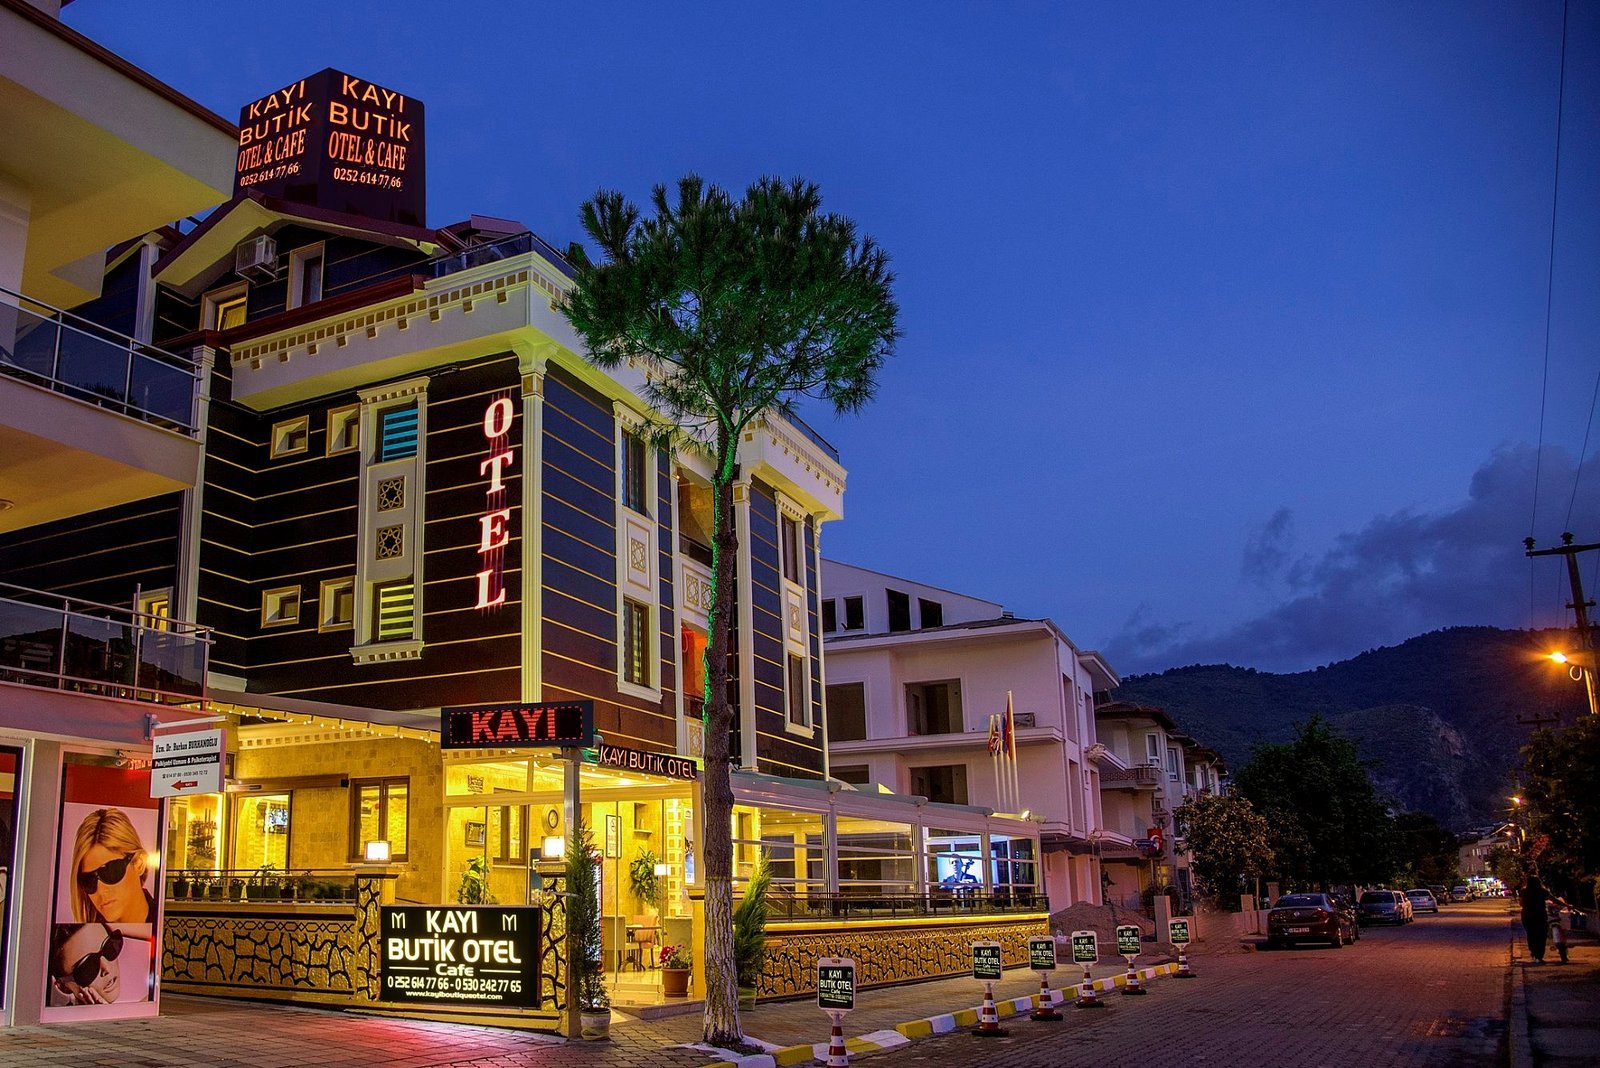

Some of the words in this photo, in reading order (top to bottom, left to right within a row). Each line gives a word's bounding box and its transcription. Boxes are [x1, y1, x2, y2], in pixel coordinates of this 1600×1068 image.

[249, 80, 306, 120] KAYI
[342, 75, 404, 113] KAYI
[240, 102, 312, 146] BUTİK
[329, 101, 412, 142] BUTİK
[238, 144, 262, 172] OTEL
[264, 140, 272, 164] &
[274, 128, 306, 162] CAFE
[328, 130, 363, 163] OTEL
[364, 138, 375, 166] &
[378, 141, 406, 171] CAFE
[240, 172, 258, 186] 0252
[260, 168, 274, 182] 614
[276, 165, 286, 178] 77
[287, 162, 299, 174] 66
[334, 168, 358, 182] 0252
[360, 172, 378, 184] 614
[379, 174, 390, 186] 77
[390, 176, 401, 188] 66
[474, 397, 514, 610] OTEL
[472, 708, 556, 742] KAYI
[600, 745, 627, 766] KAYI
[630, 752, 664, 773] BUTİK
[668, 759, 696, 778] OTEL
[426, 910, 478, 934] KAYI
[388, 933, 456, 962] BUTİK
[463, 939, 522, 964] OTEL
[436, 963, 474, 977] Cafe
[480, 979, 497, 991] 242
[510, 980, 522, 992] 65
[829, 970, 842, 978] KAYI
[837, 981, 852, 990] OTEL
